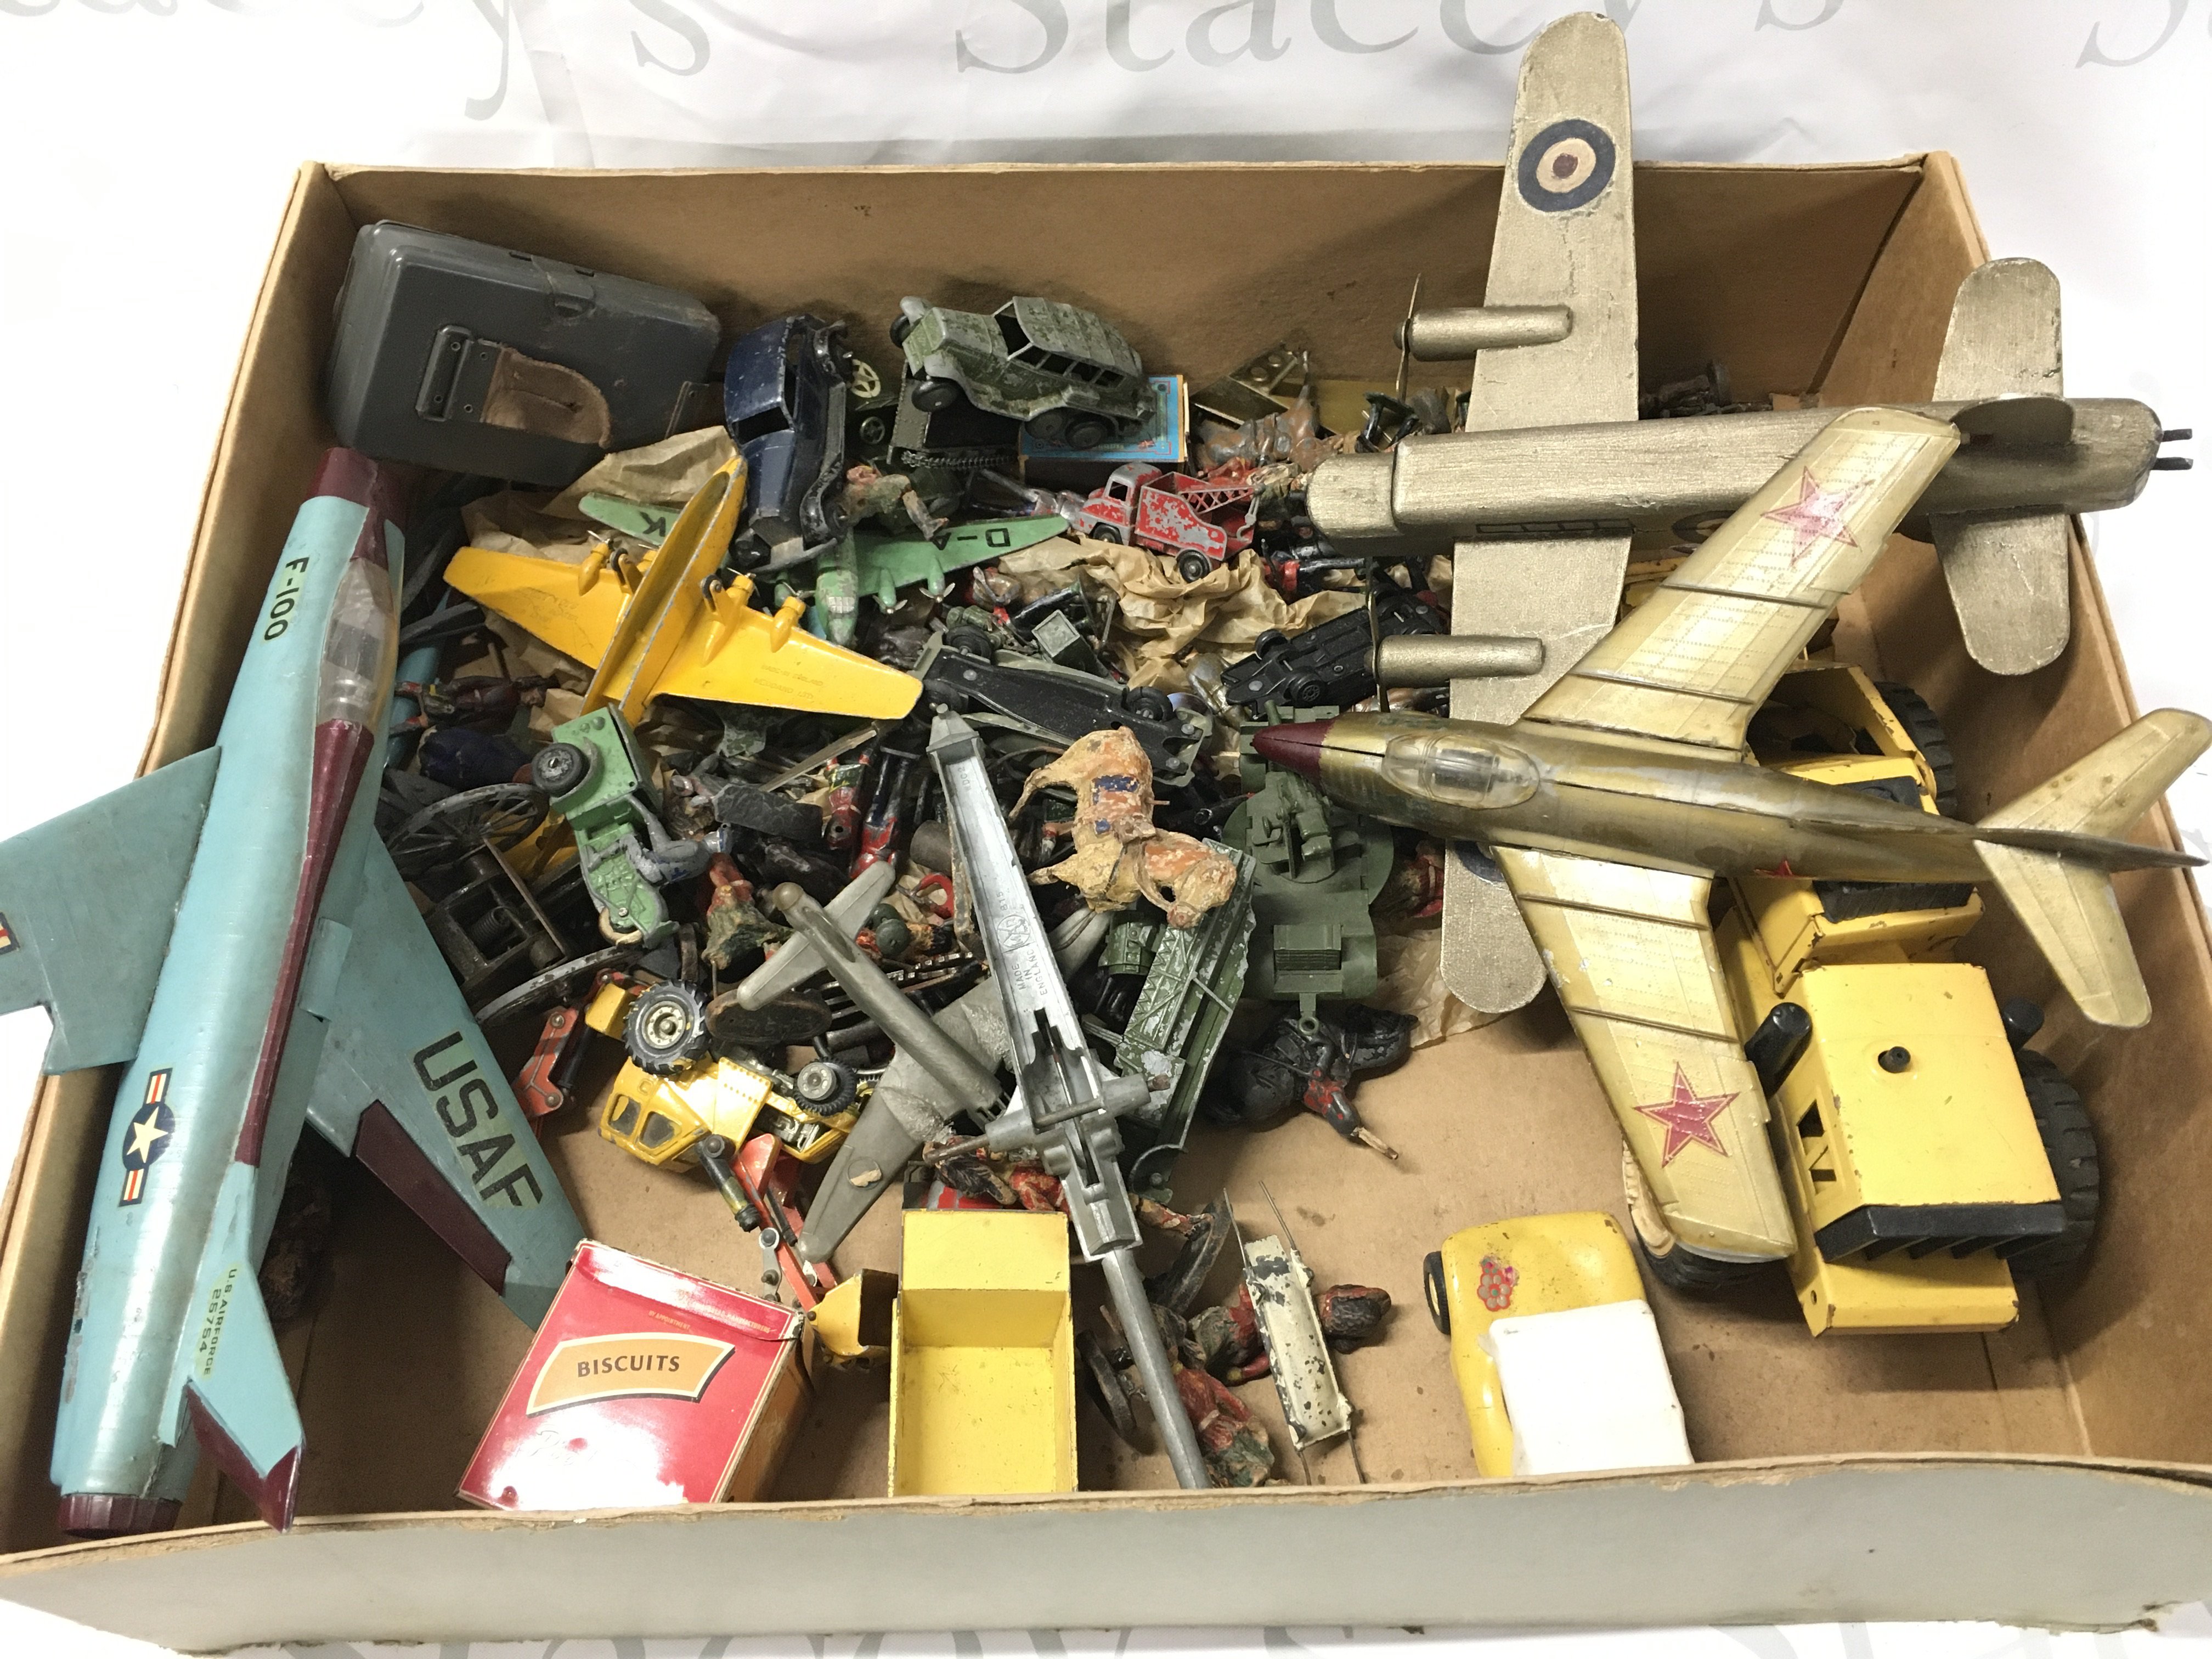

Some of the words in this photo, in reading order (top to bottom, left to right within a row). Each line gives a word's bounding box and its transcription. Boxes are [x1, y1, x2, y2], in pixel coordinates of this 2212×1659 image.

[264, 556, 310, 641] F-100
[996, 891, 1008, 911] 815
[1012, 963, 1026, 990] MADE
[1023, 969, 1032, 980] IN
[1027, 949, 1048, 996] ENGLAND
[413, 1031, 544, 1207] USAF
[577, 1355, 680, 1378] BISCUITS
